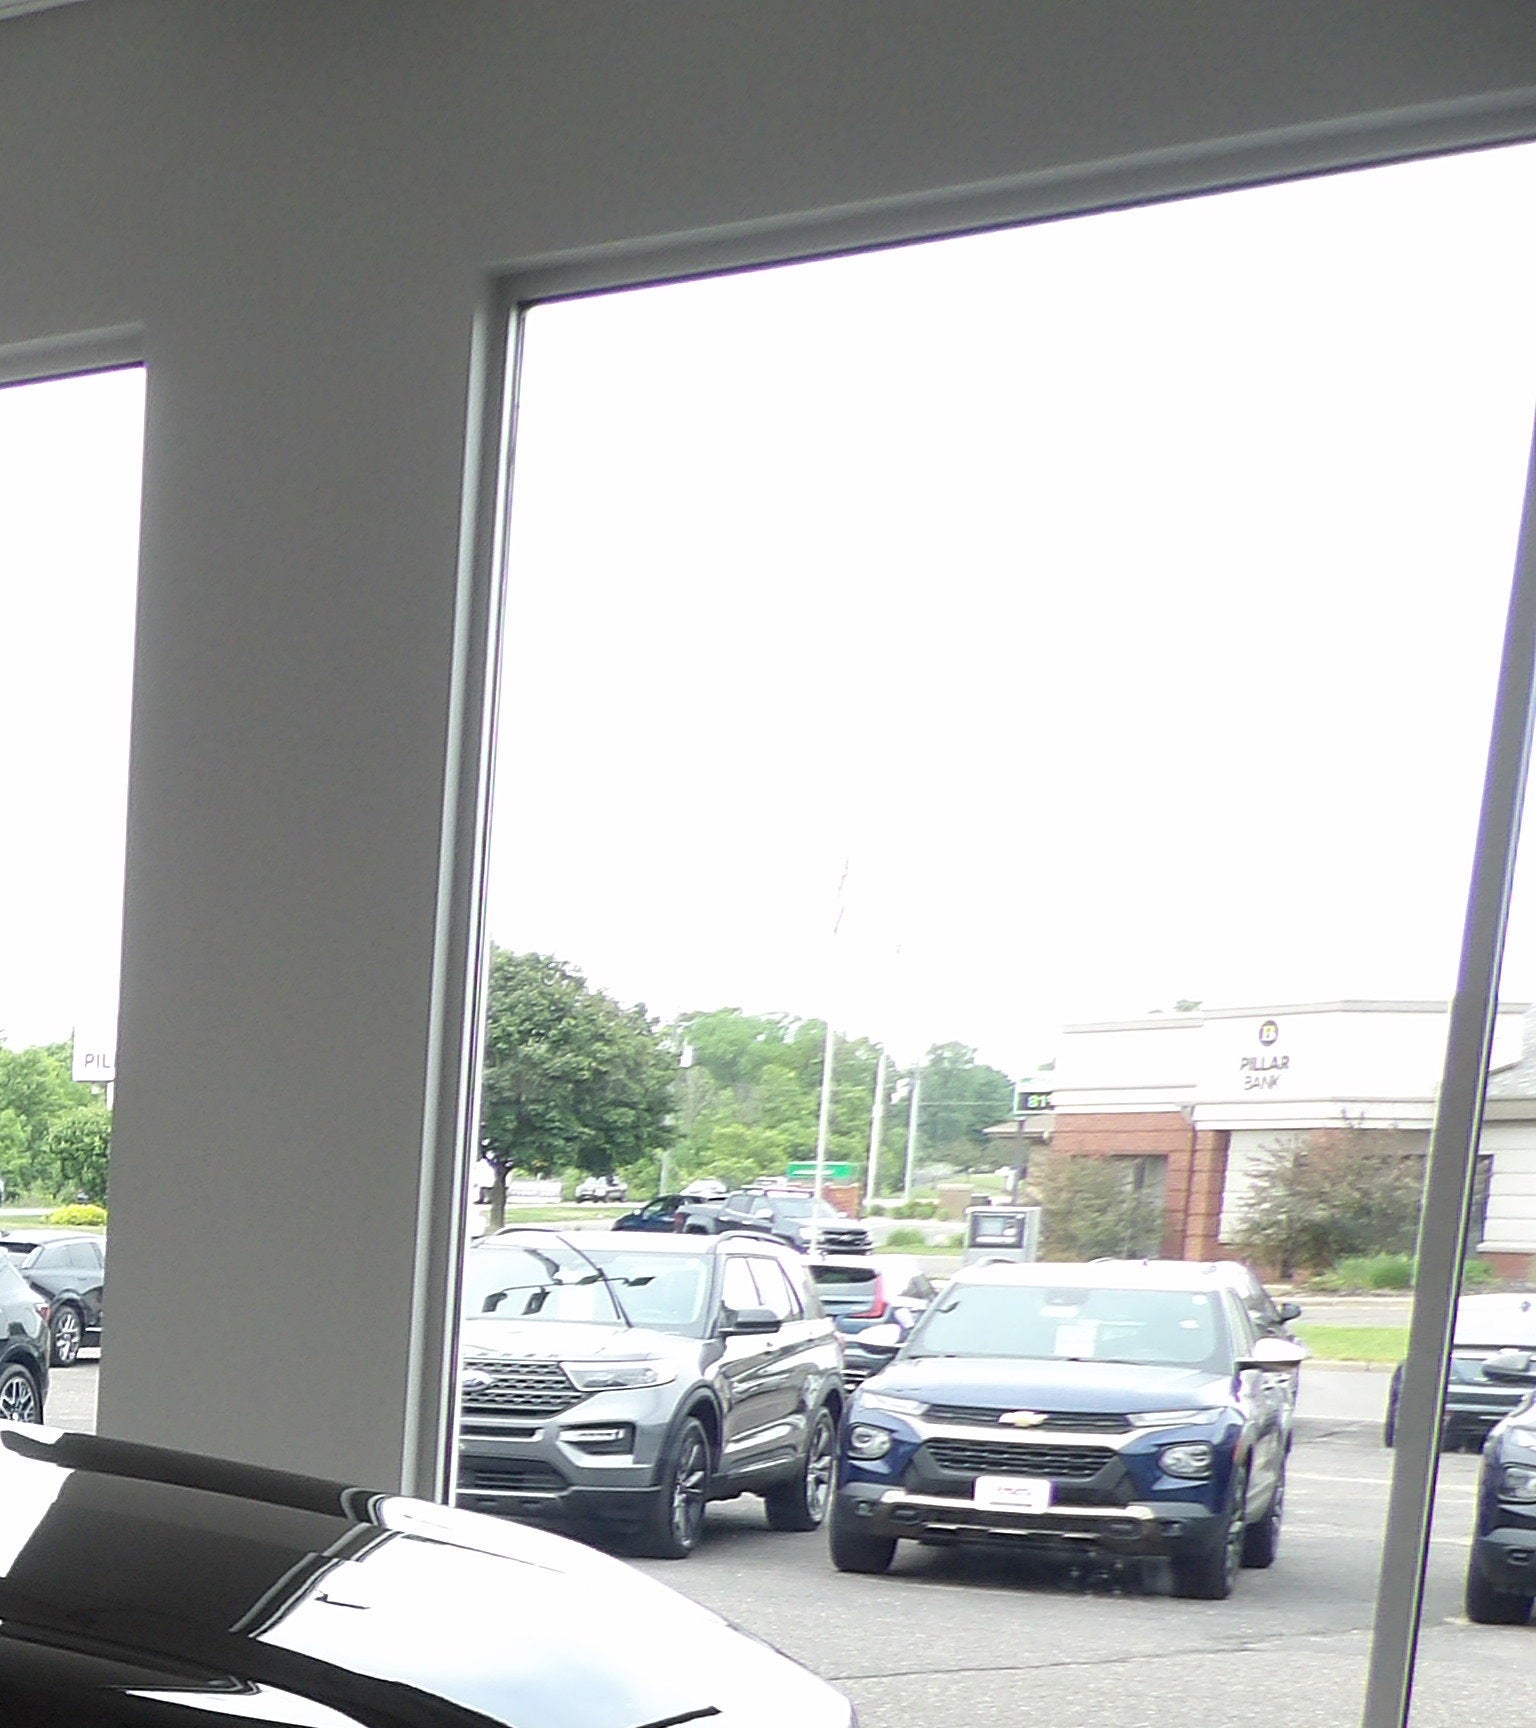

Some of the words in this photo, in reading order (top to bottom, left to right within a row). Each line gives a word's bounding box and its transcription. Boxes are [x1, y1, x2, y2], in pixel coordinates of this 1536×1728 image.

[84, 1053, 111, 1069] PIL
[1240, 1055, 1290, 1071] PILLAR
[1244, 1075, 1281, 1091] BANK
